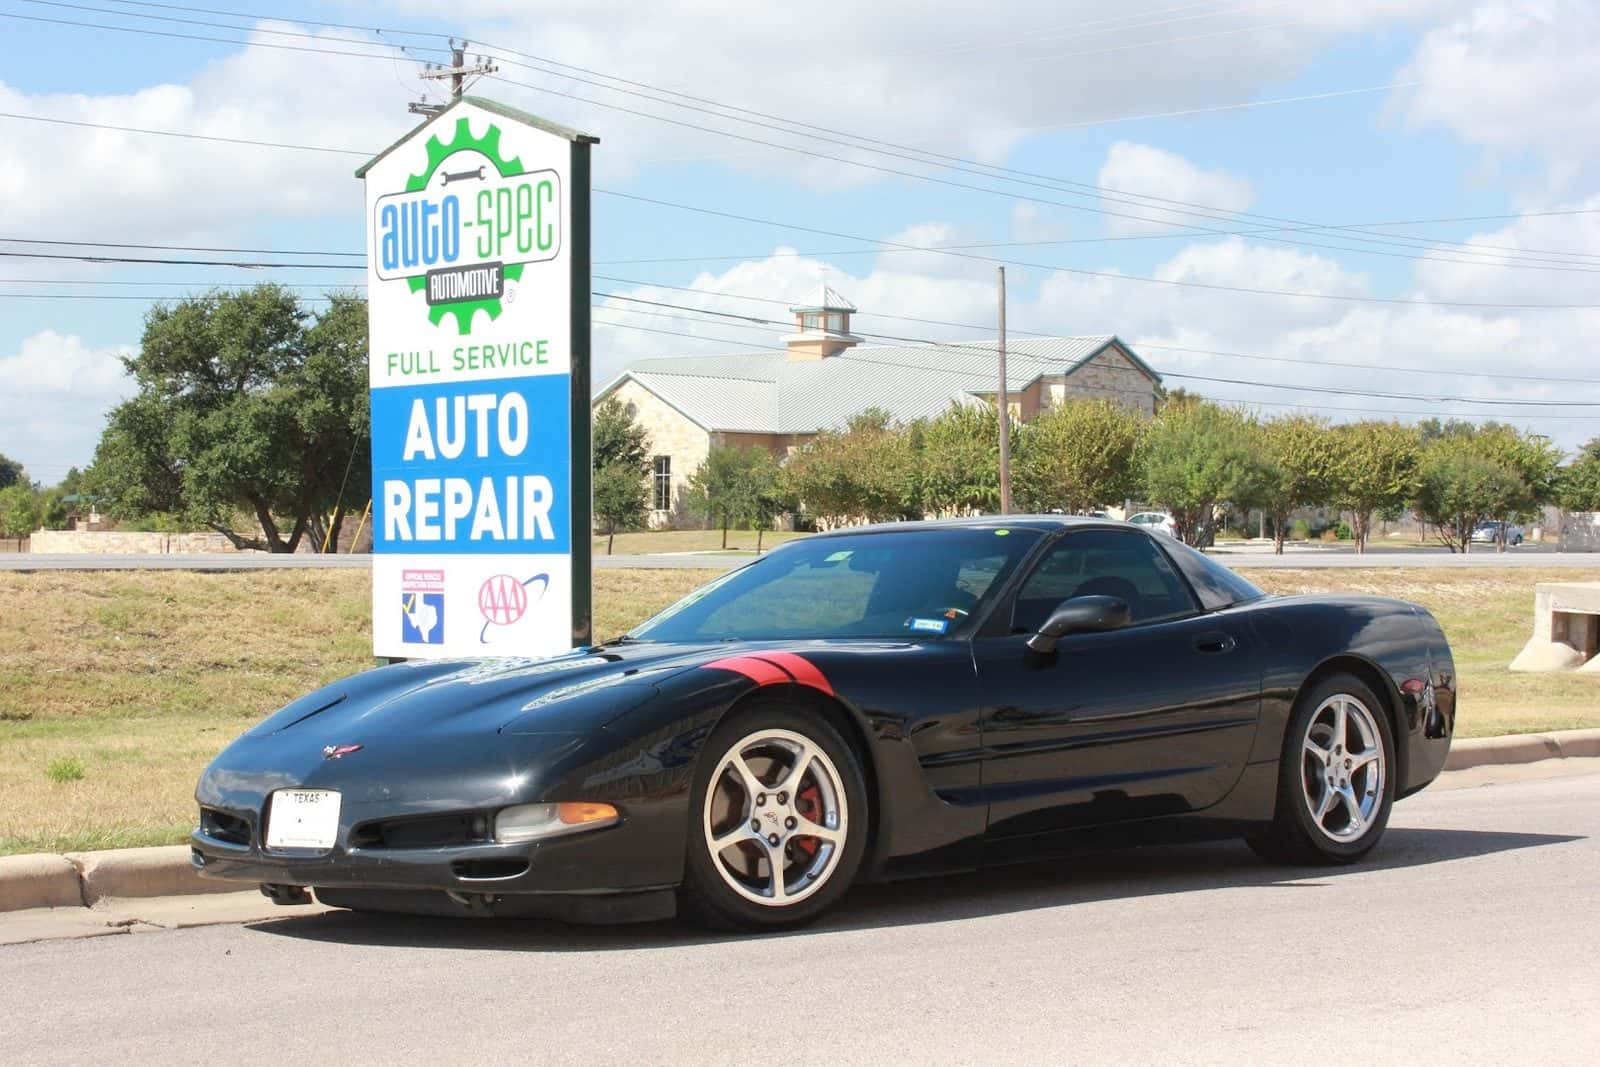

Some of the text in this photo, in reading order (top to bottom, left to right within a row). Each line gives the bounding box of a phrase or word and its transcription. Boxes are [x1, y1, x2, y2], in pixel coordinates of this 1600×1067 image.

[431, 268, 499, 301] AUTOMOTIVE
[387, 340, 549, 376] FULL SERVICE
[402, 392, 529, 461] AUTO
[384, 475, 555, 542] REPAIR
[482, 577, 523, 625] AAA
[294, 792, 320, 804] TEXAS
